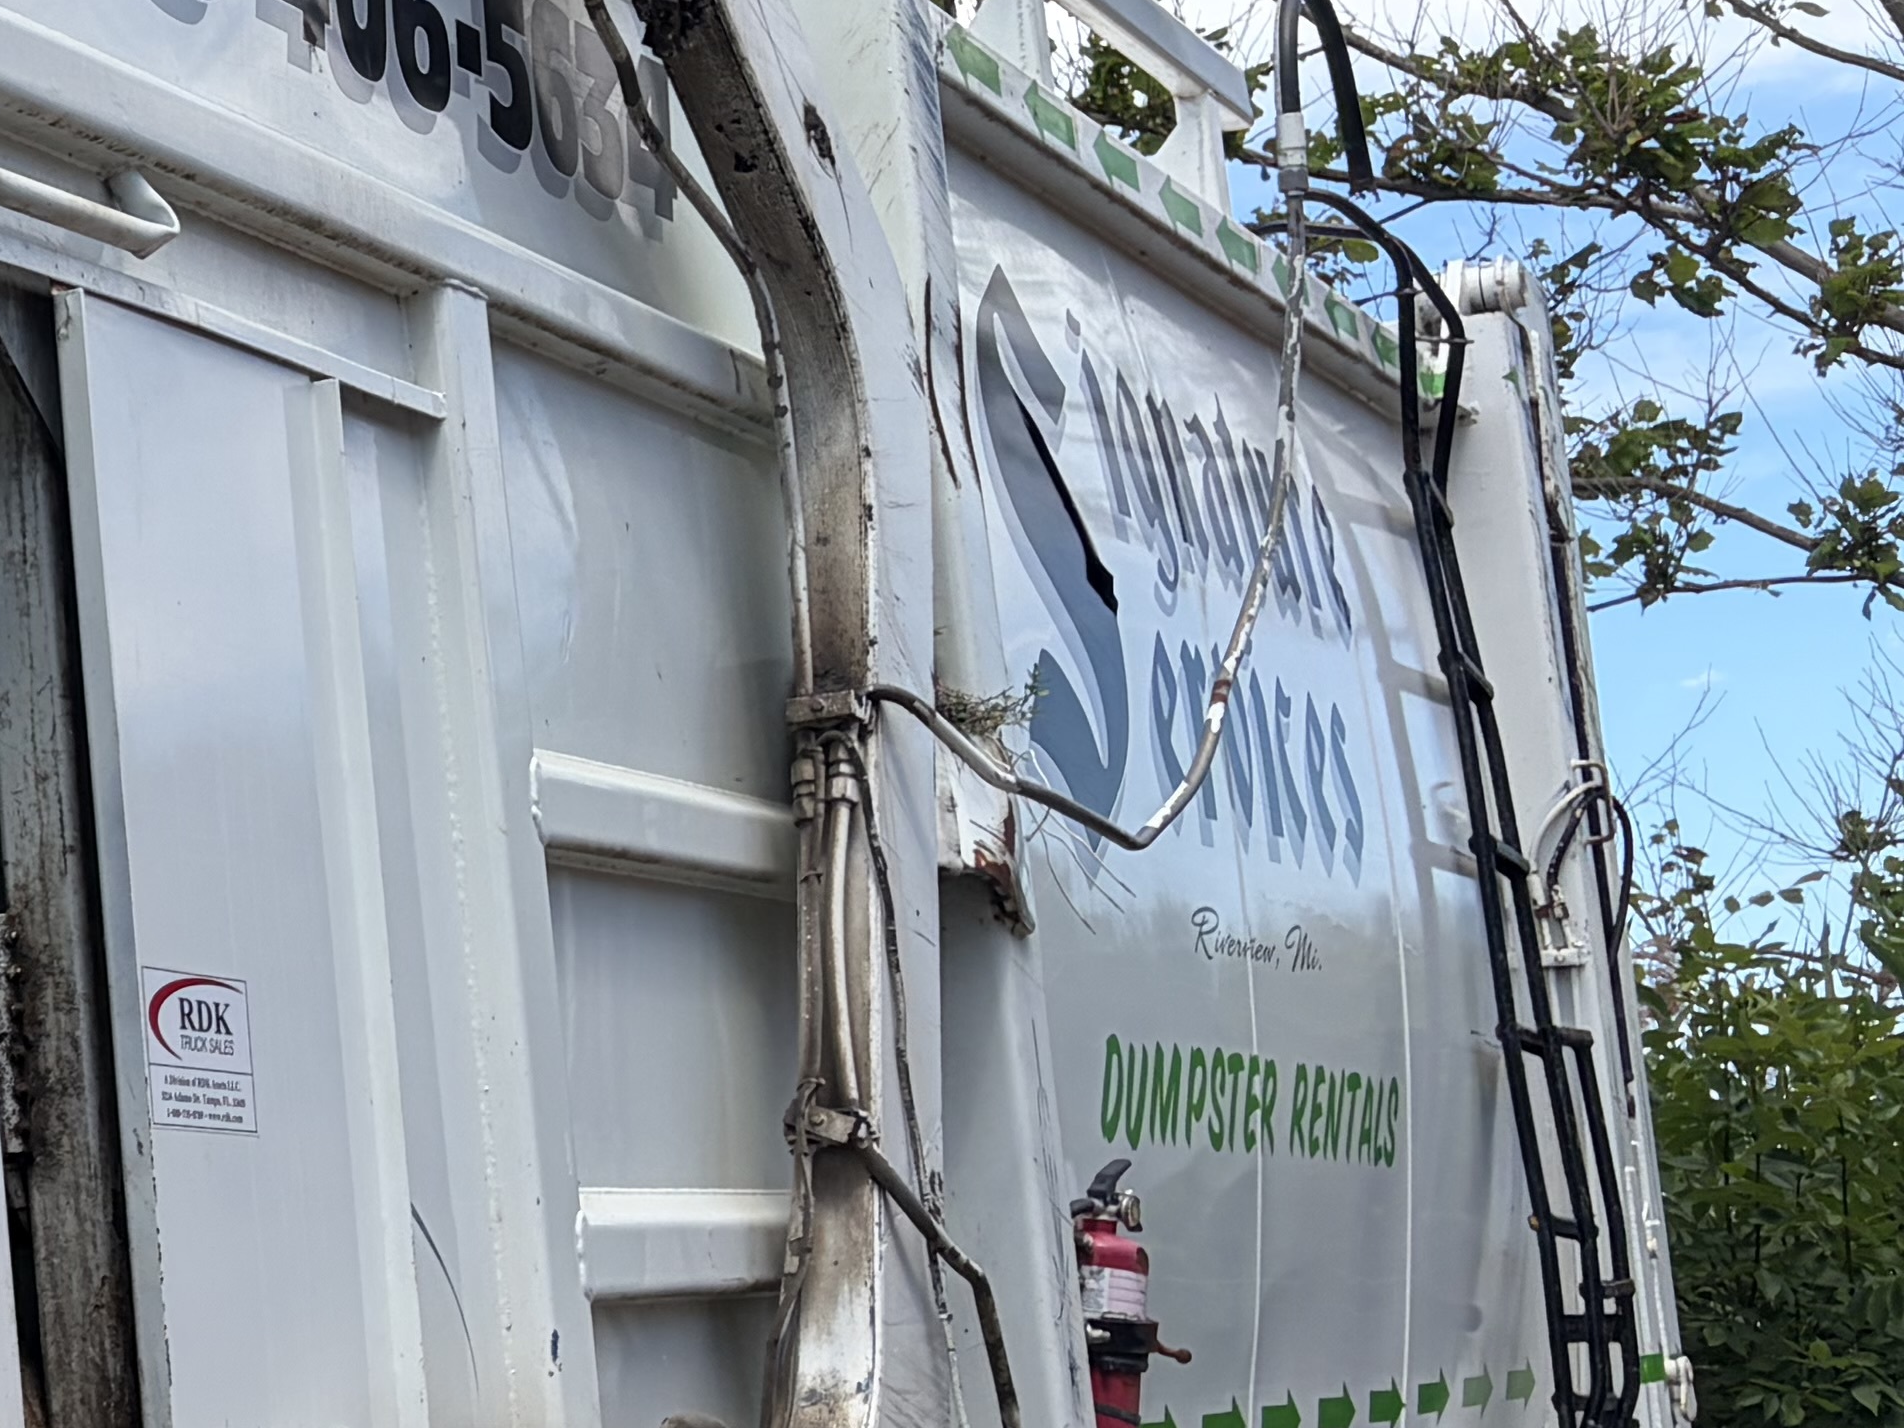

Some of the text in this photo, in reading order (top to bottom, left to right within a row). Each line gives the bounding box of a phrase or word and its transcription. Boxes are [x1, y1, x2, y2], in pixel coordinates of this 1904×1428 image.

[1284, 924, 1323, 972] Mi.
[178, 997, 234, 1036] RDK
[180, 1034, 235, 1057] TRUCK SALES
[1101, 1033, 1399, 1169] DUMPSTER RENTALS
